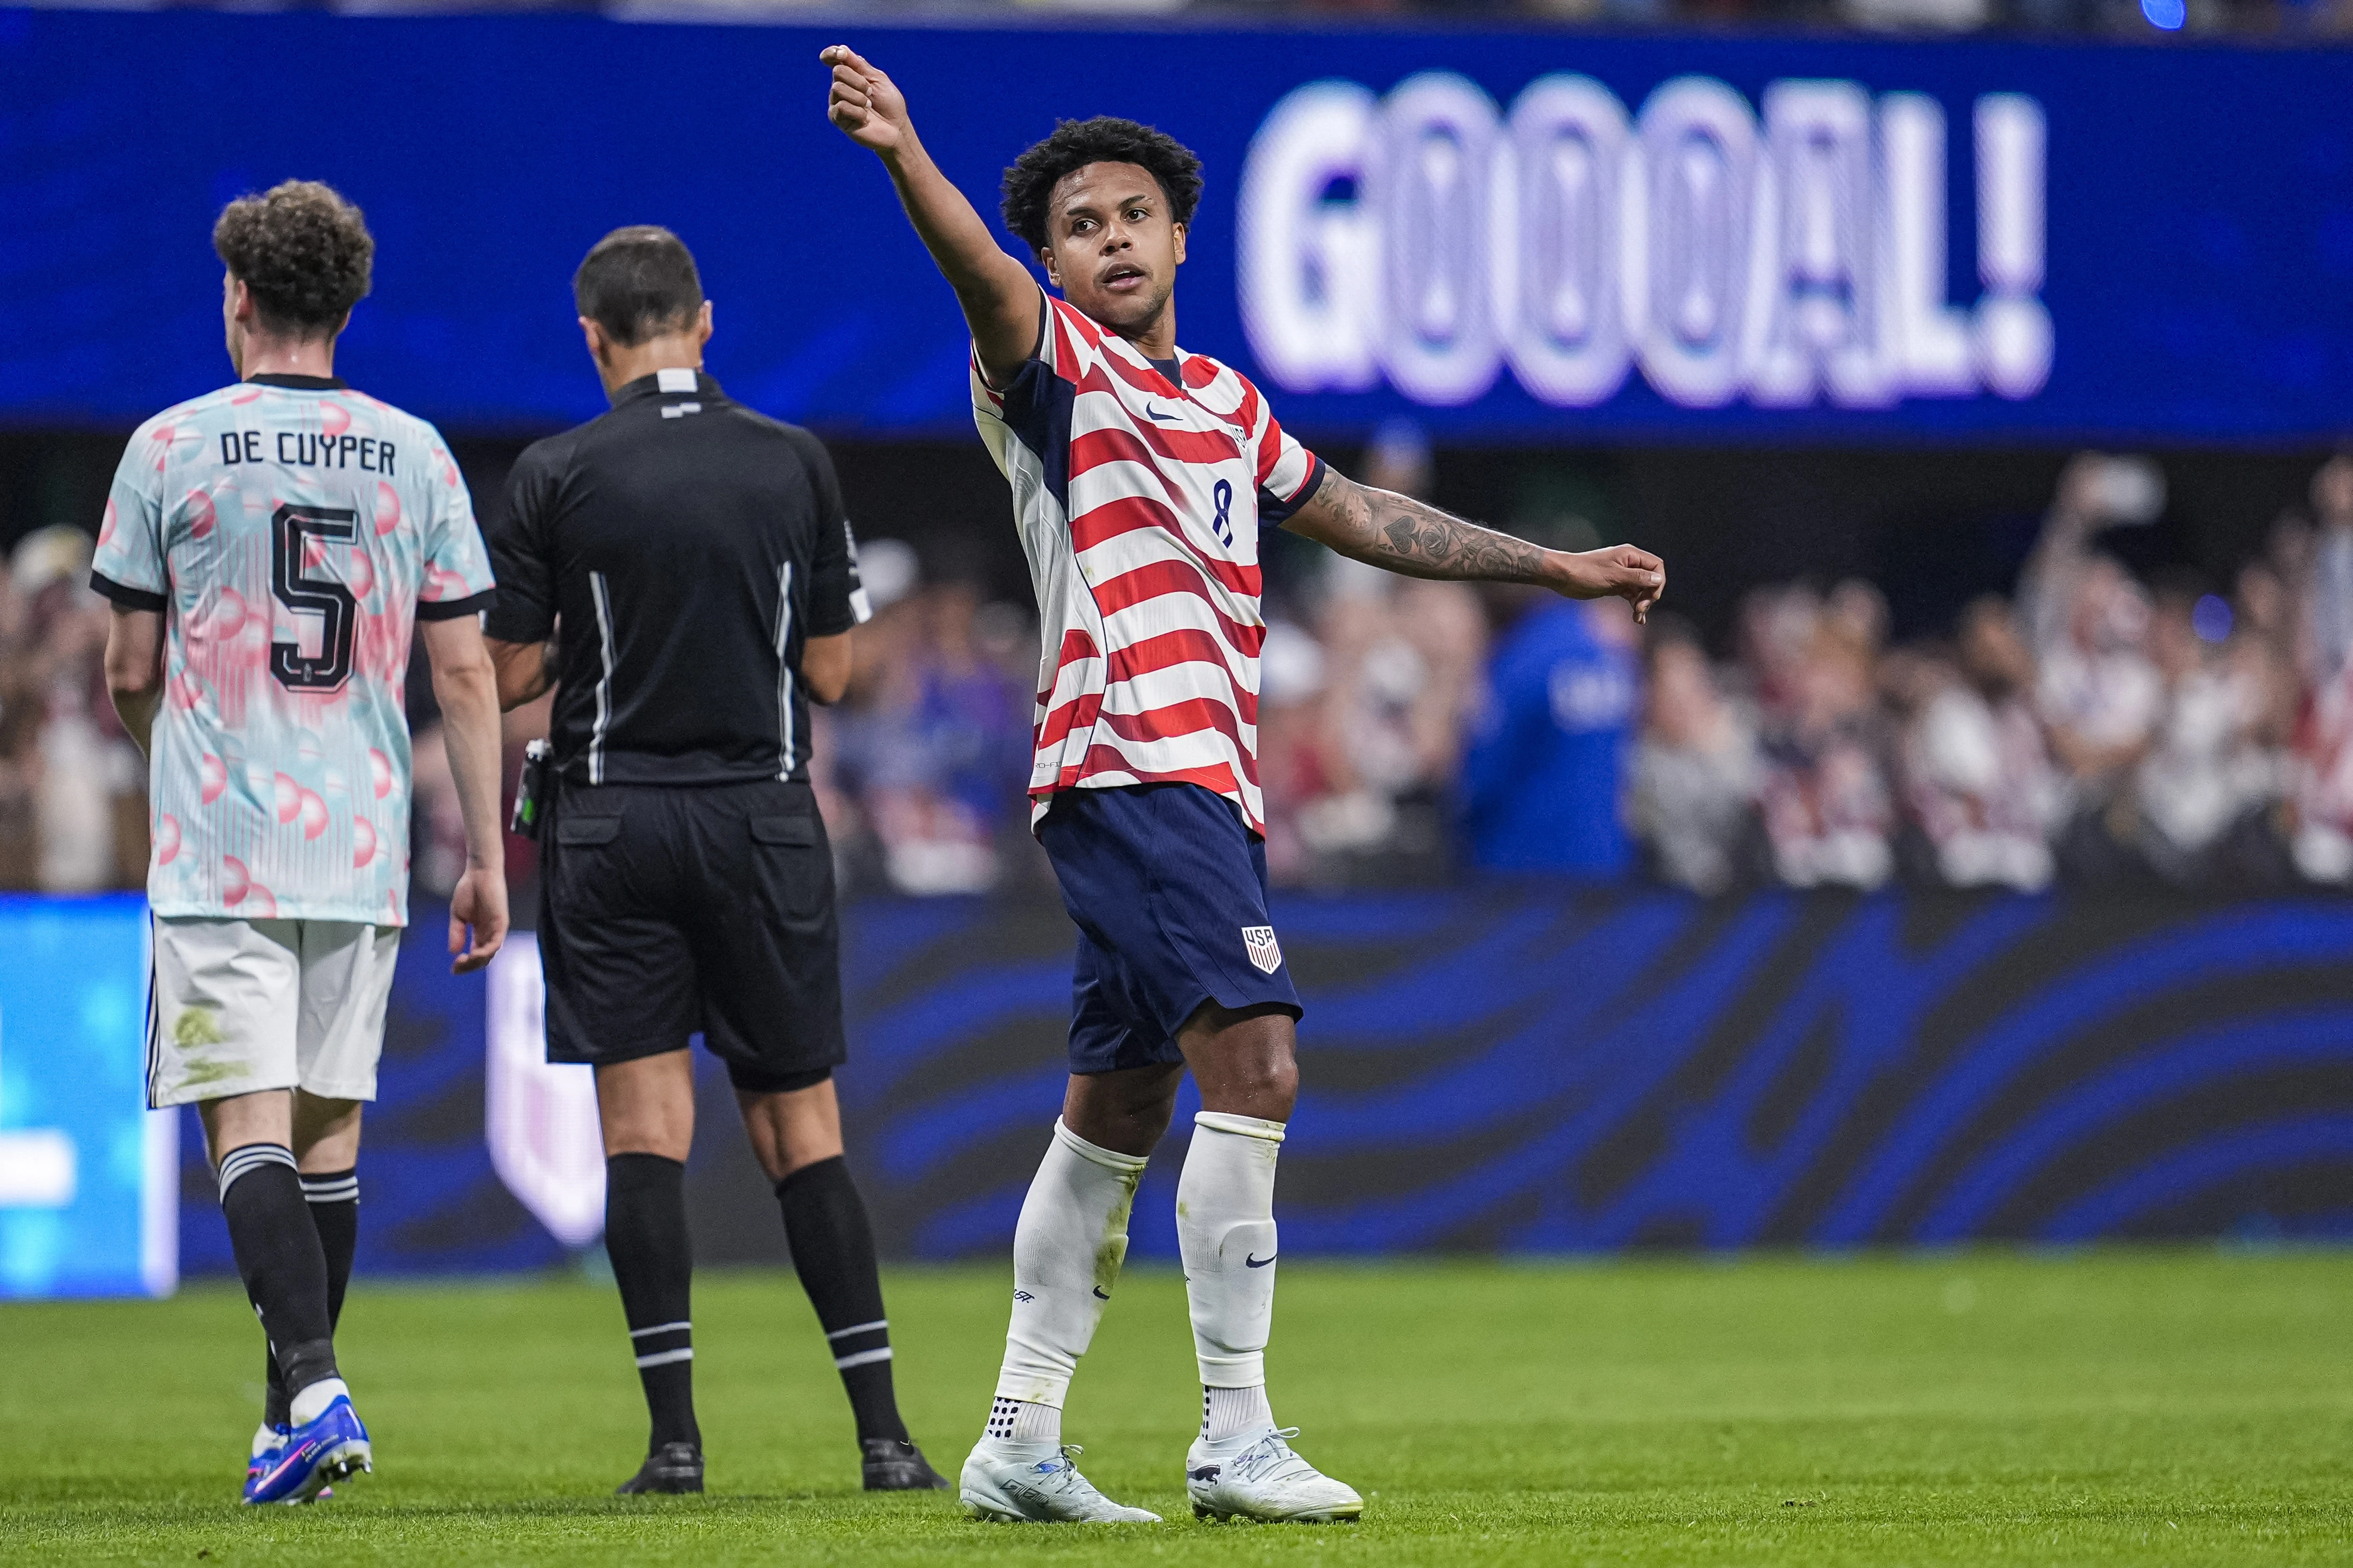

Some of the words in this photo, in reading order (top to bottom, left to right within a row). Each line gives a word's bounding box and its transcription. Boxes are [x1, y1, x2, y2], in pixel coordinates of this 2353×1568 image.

[1237, 70, 2054, 406] GOOOAL!
[221, 431, 264, 466] DE
[277, 433, 396, 476] CUYPER
[1213, 478, 1233, 549] 8
[271, 503, 360, 694] 5
[1245, 929, 1273, 947] USA
